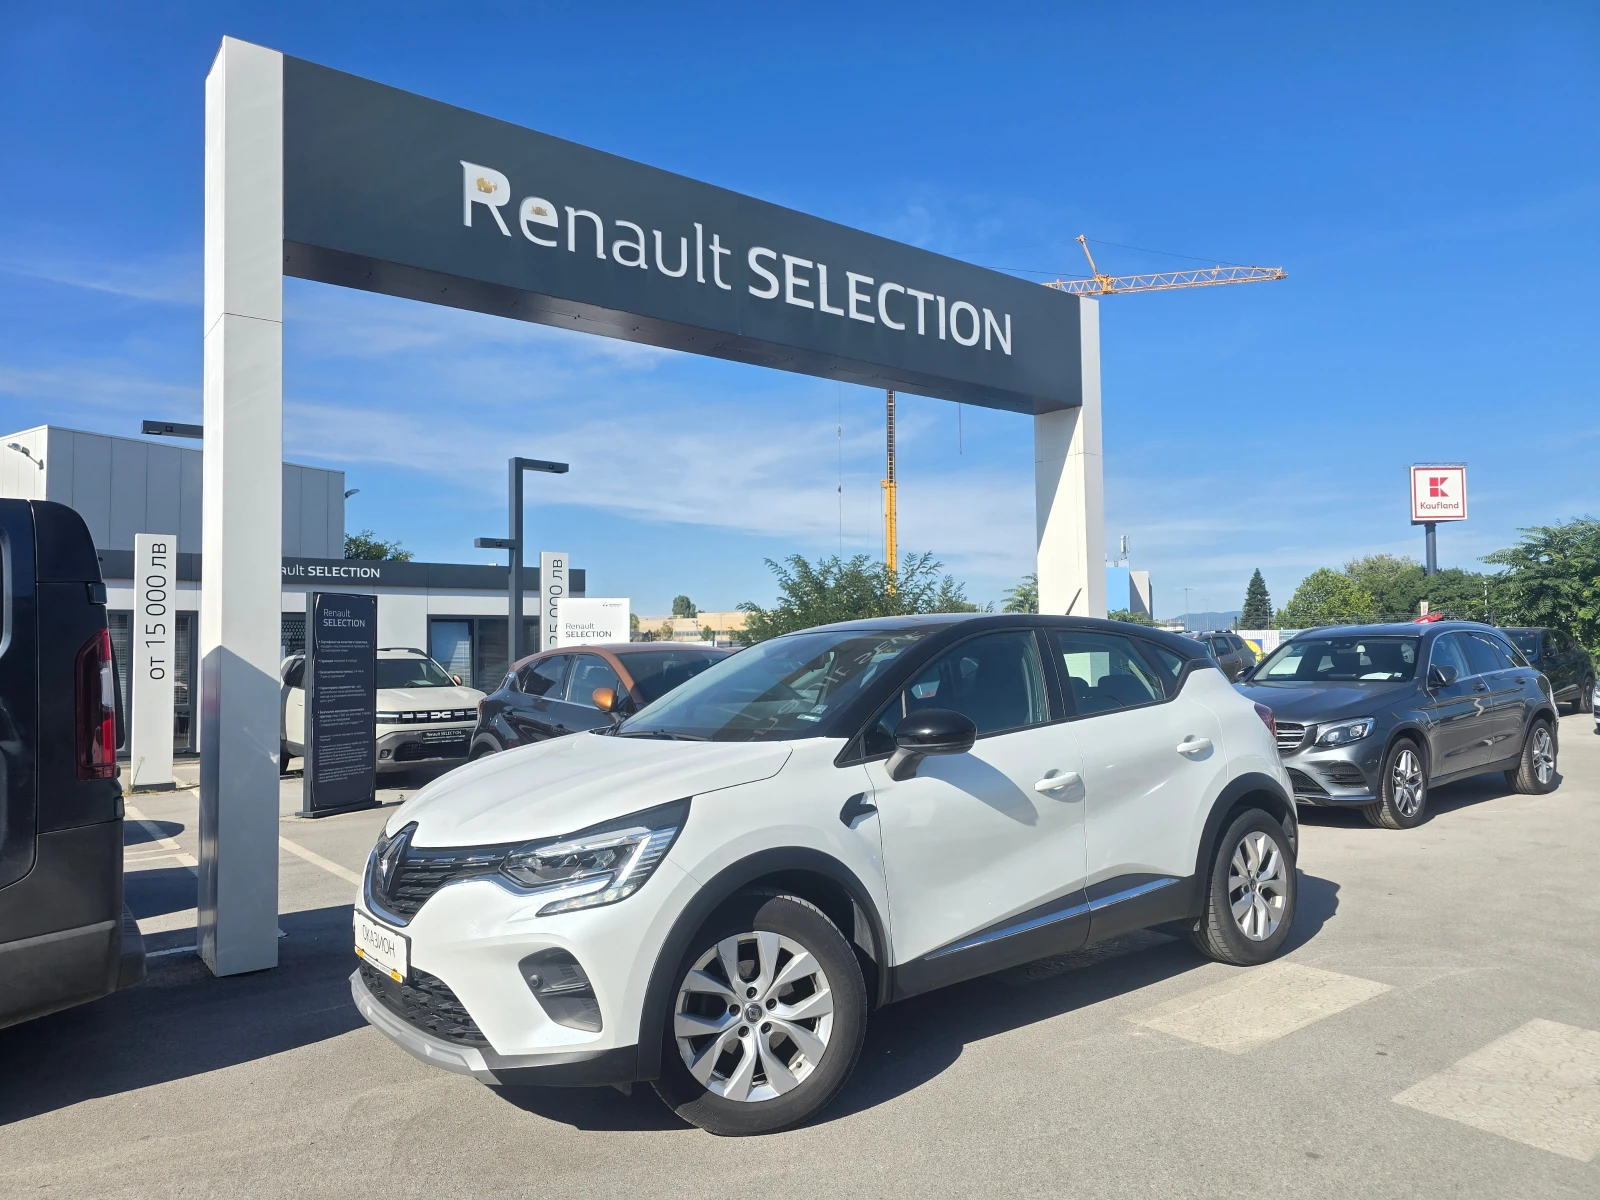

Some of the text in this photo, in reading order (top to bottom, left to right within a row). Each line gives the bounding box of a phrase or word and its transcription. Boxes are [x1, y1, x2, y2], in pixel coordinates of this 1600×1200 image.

[460, 160, 1012, 356] Renault SELECTION
[308, 566, 380, 578] SELECTION
[146, 575, 167, 616] 000
[323, 609, 350, 618] Renault
[323, 619, 366, 627] SELECTION
[146, 623, 165, 648] 15
[362, 924, 396, 957] ОКАЗИОН
